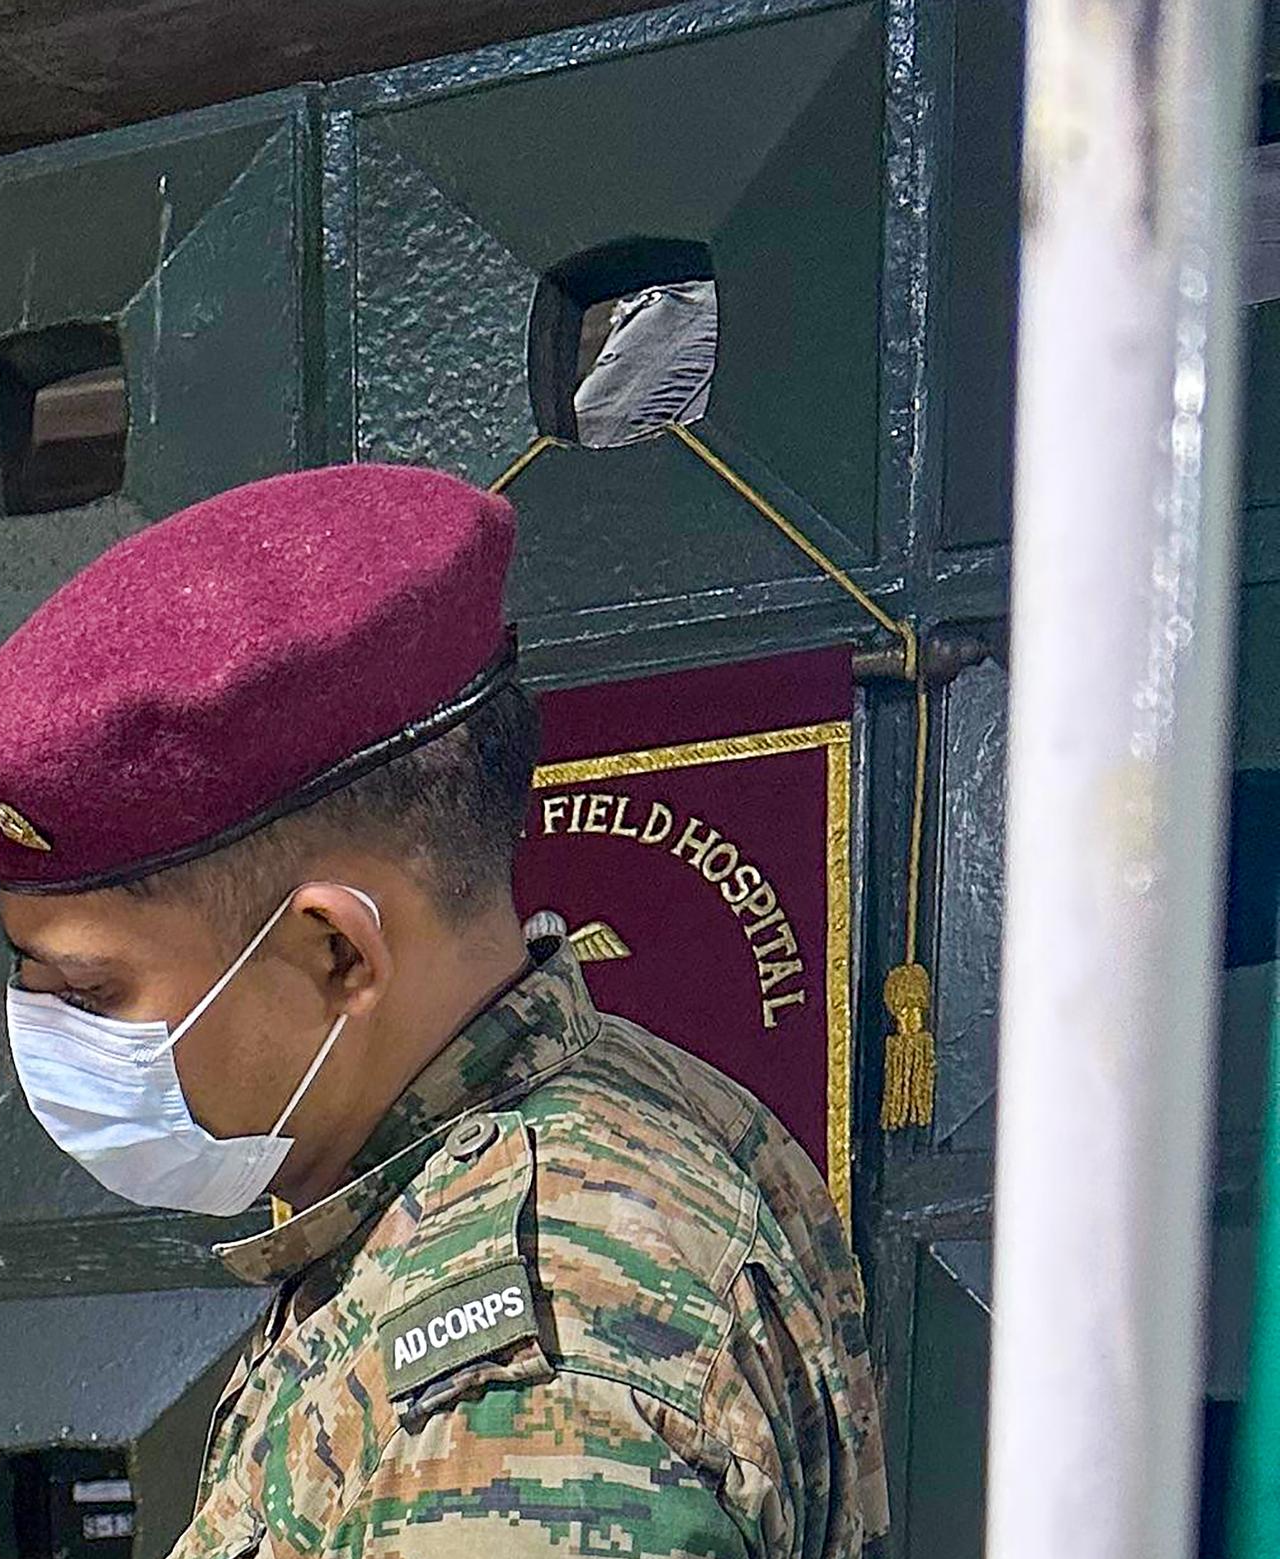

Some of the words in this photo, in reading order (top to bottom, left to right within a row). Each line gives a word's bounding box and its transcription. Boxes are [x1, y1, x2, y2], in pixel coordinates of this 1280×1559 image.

[542, 794, 673, 844] FIELD
[671, 818, 806, 1028] HOSPITAL
[427, 1286, 525, 1349] CORPS
